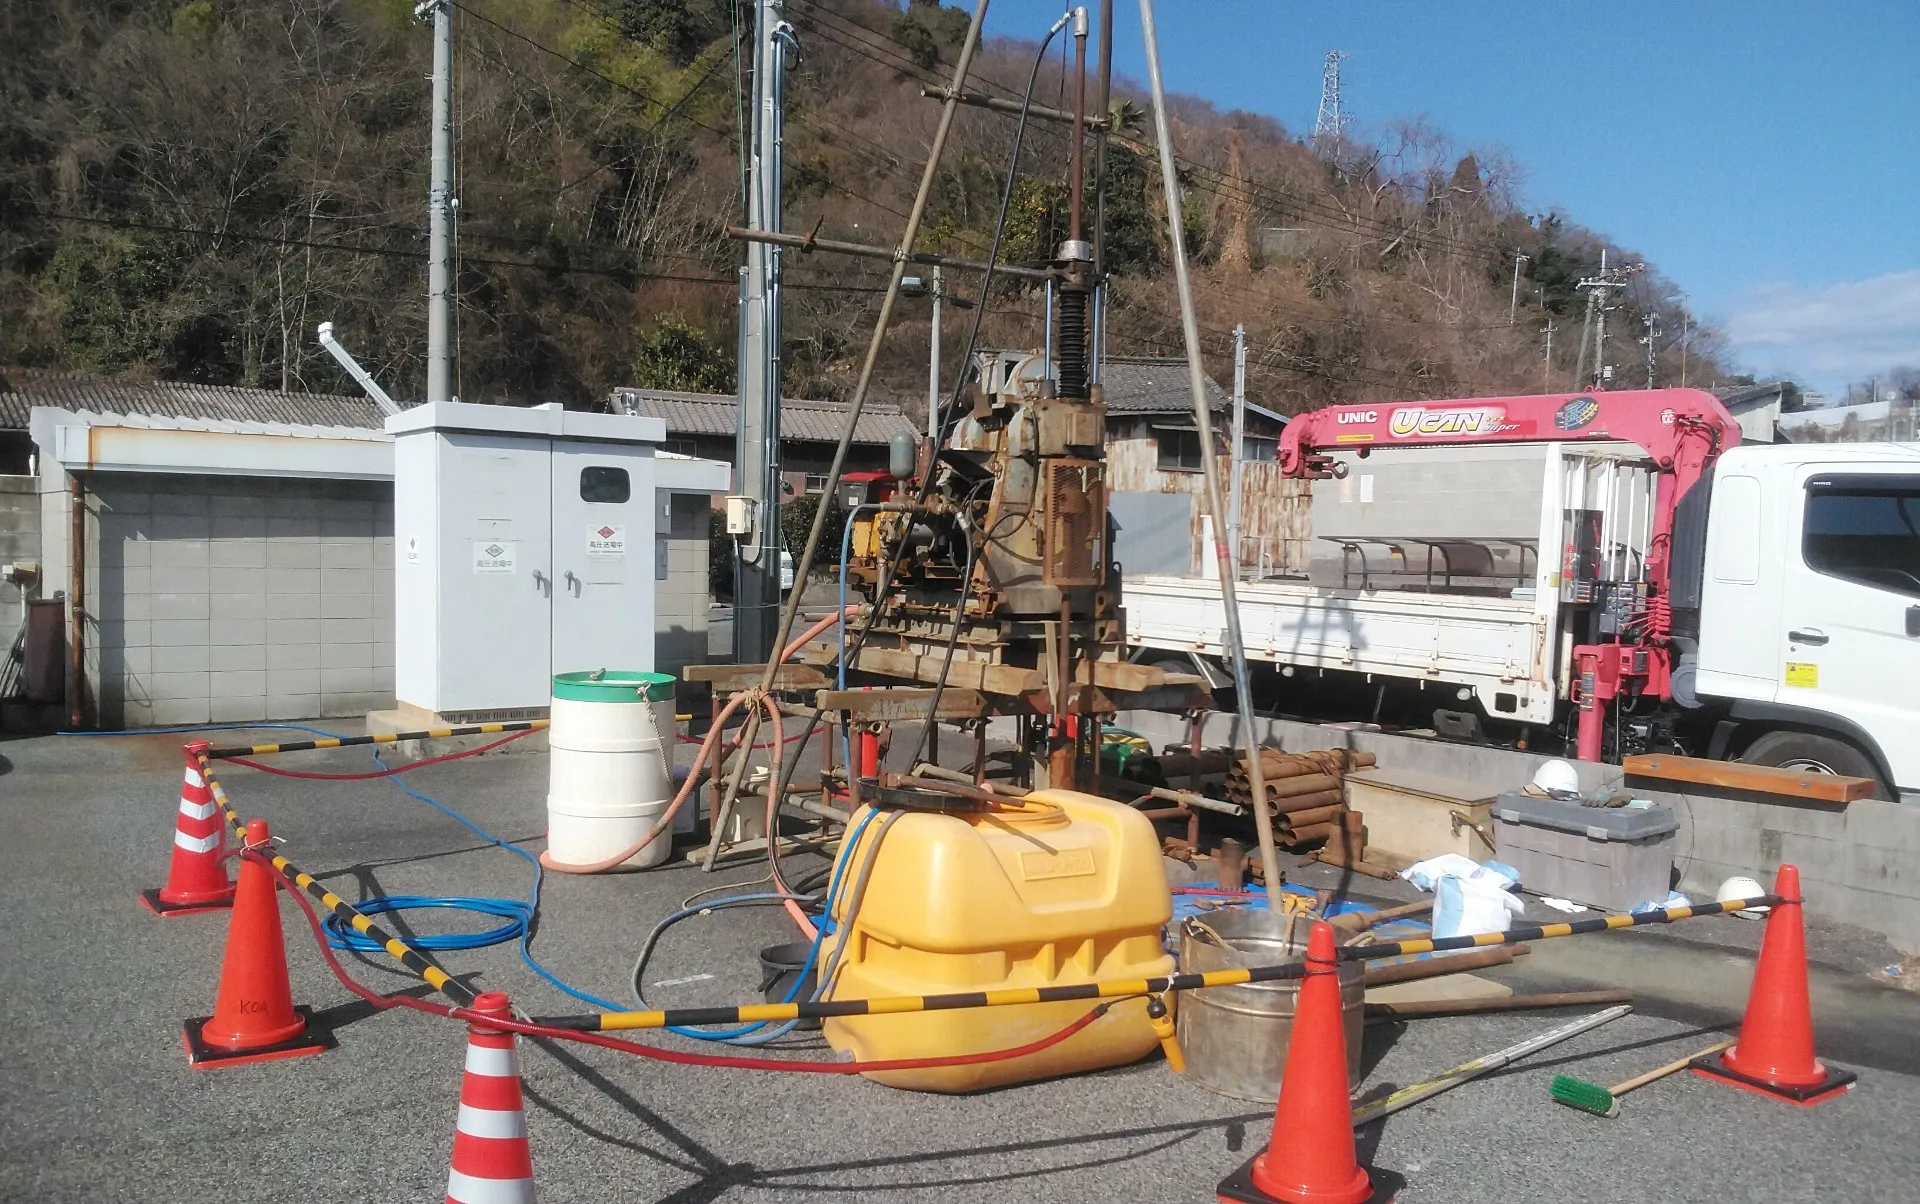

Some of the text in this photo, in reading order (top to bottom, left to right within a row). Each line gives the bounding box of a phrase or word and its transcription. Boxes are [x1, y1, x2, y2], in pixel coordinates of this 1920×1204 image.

[1337, 410, 1378, 424] UNIC
[1484, 423, 1521, 433] Super
[240, 999, 269, 1016] KOA
